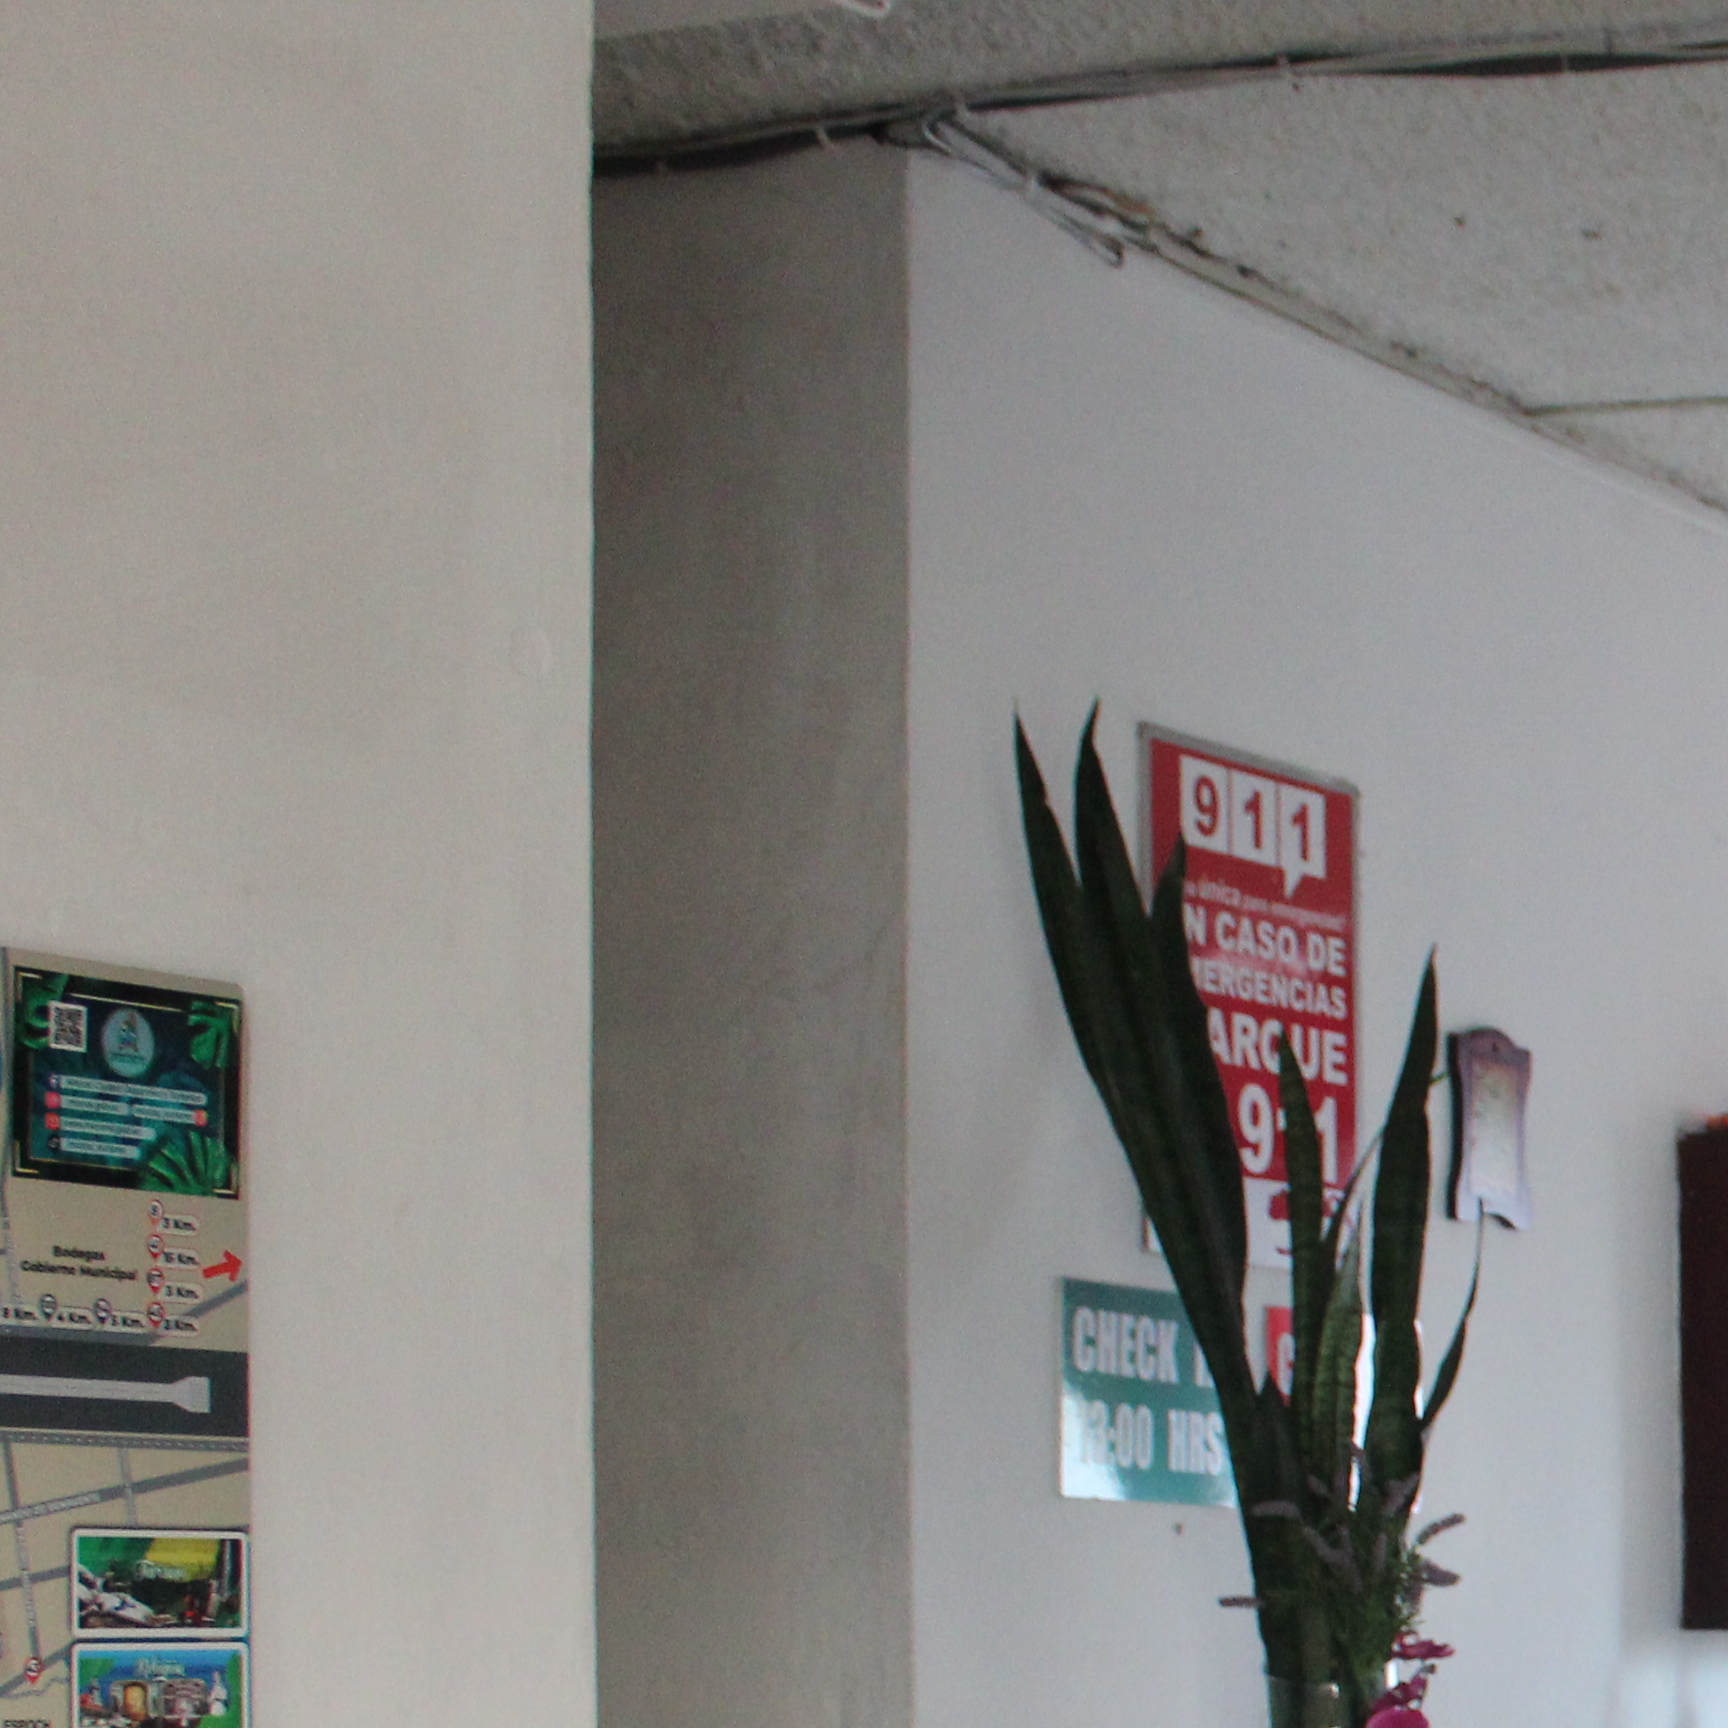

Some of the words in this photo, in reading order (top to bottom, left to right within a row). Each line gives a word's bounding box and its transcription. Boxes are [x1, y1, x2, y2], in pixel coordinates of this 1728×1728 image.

[1193, 775, 1310, 863] 911
[1182, 901, 1207, 946] N
[1214, 911, 1299, 963] CASO
[1306, 931, 1347, 977] DE
[1073, 1306, 1180, 1383] CHECK
[1167, 1408, 1224, 1476] HRS
